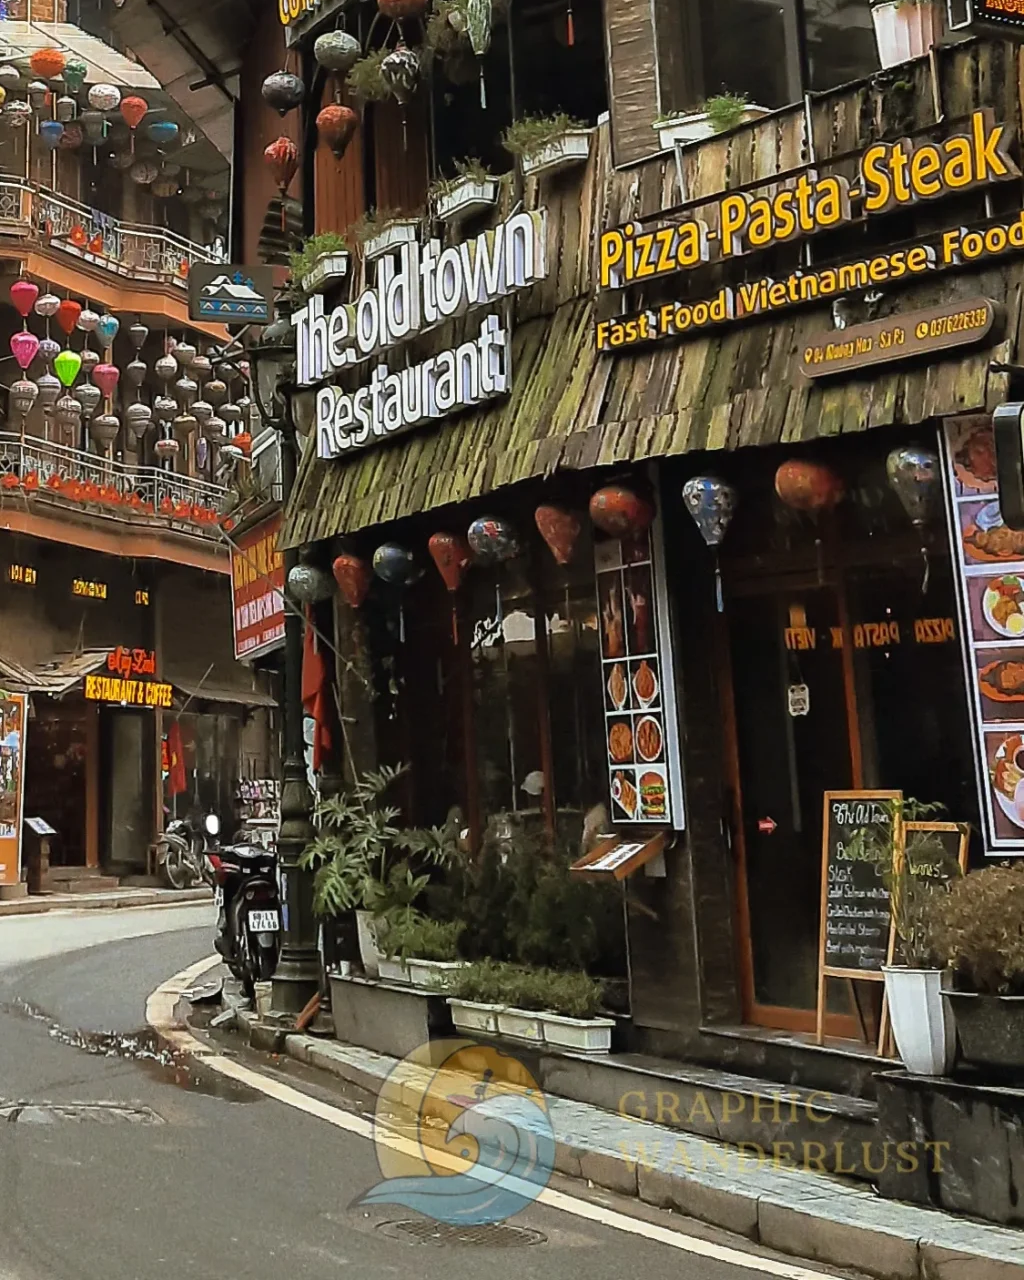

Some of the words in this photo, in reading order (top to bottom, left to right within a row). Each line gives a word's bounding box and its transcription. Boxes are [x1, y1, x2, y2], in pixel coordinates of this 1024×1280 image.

[599, 221, 701, 288] Pizza
[720, 174, 840, 255] Pasta
[861, 111, 1008, 211] Steak
[291, 296, 350, 387] The
[357, 241, 417, 354] old
[419, 212, 542, 321] town
[597, 314, 650, 350] Fast
[660, 294, 727, 336] Food
[739, 246, 927, 314] Vietnamese
[943, 211, 1024, 266] Food
[315, 315, 508, 459] Restaurant
[85, 675, 137, 703] RESTAURANT
[137, 681, 144, 704] &
[145, 682, 173, 707] COFFEE
